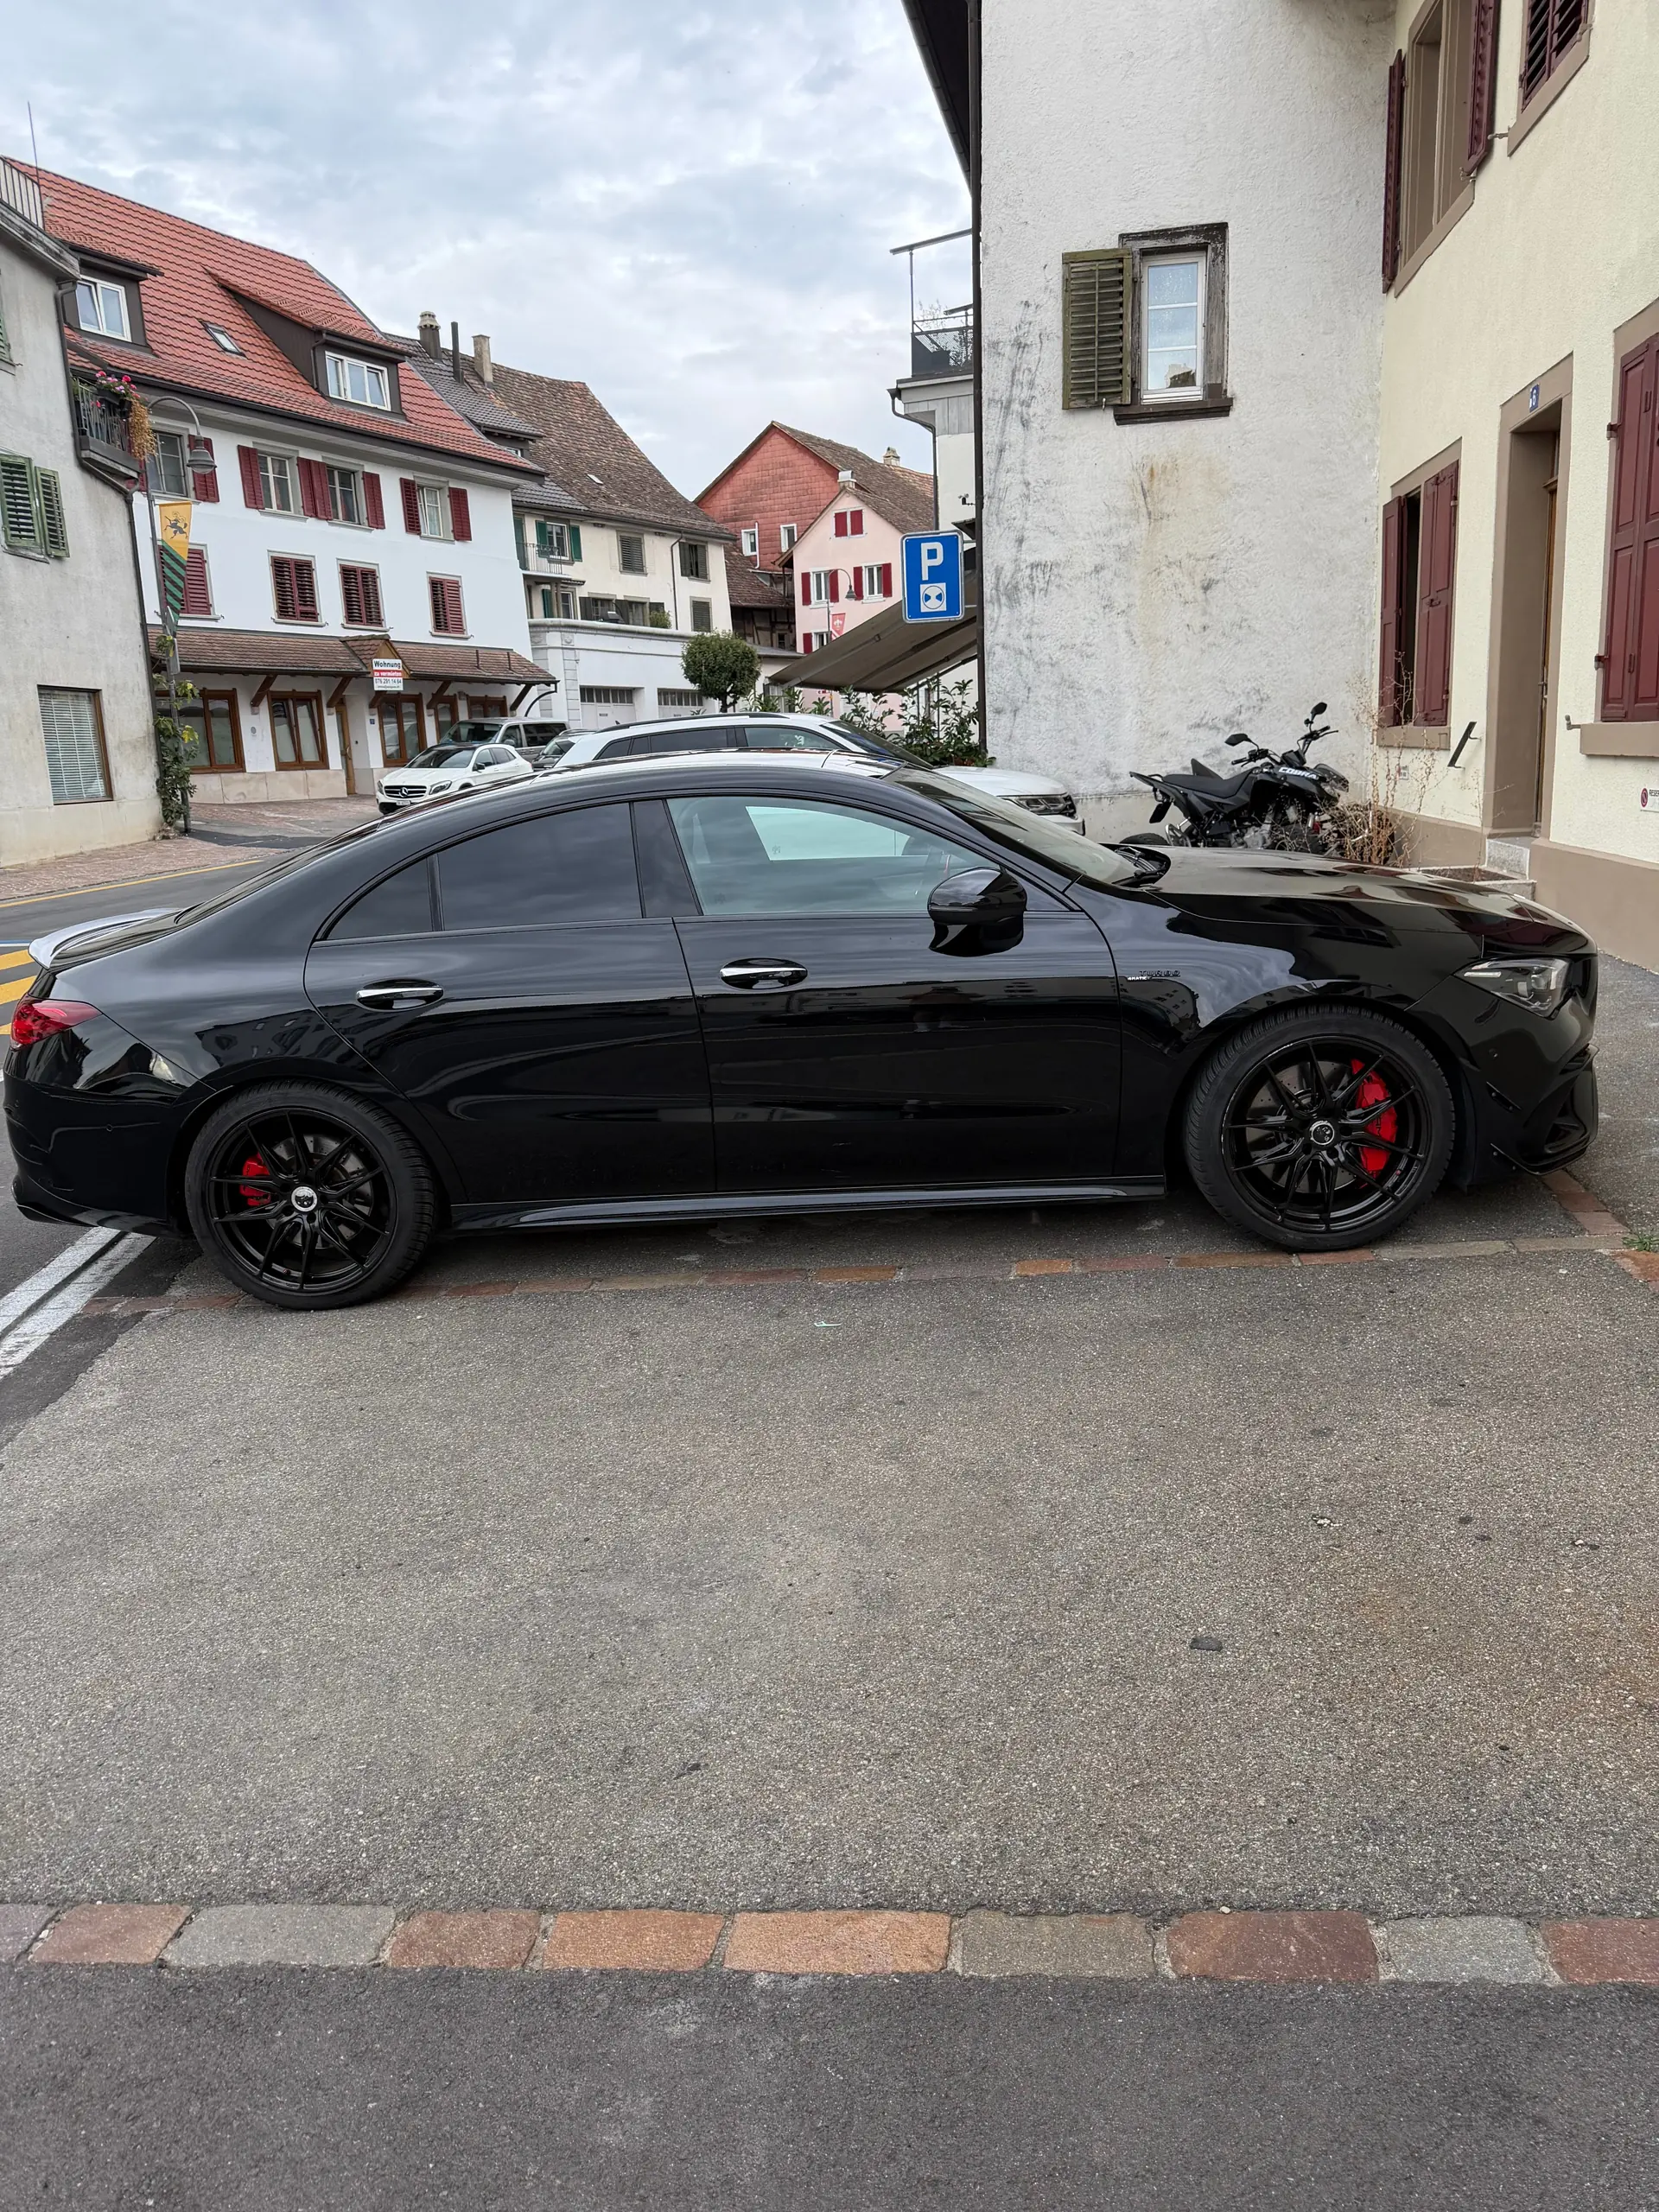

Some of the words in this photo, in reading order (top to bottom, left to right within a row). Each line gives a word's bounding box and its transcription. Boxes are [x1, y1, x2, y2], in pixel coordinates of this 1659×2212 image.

[920, 541, 944, 581] P
[373, 660, 401, 669] Wohnung
[1279, 766, 1319, 780] COBRA
